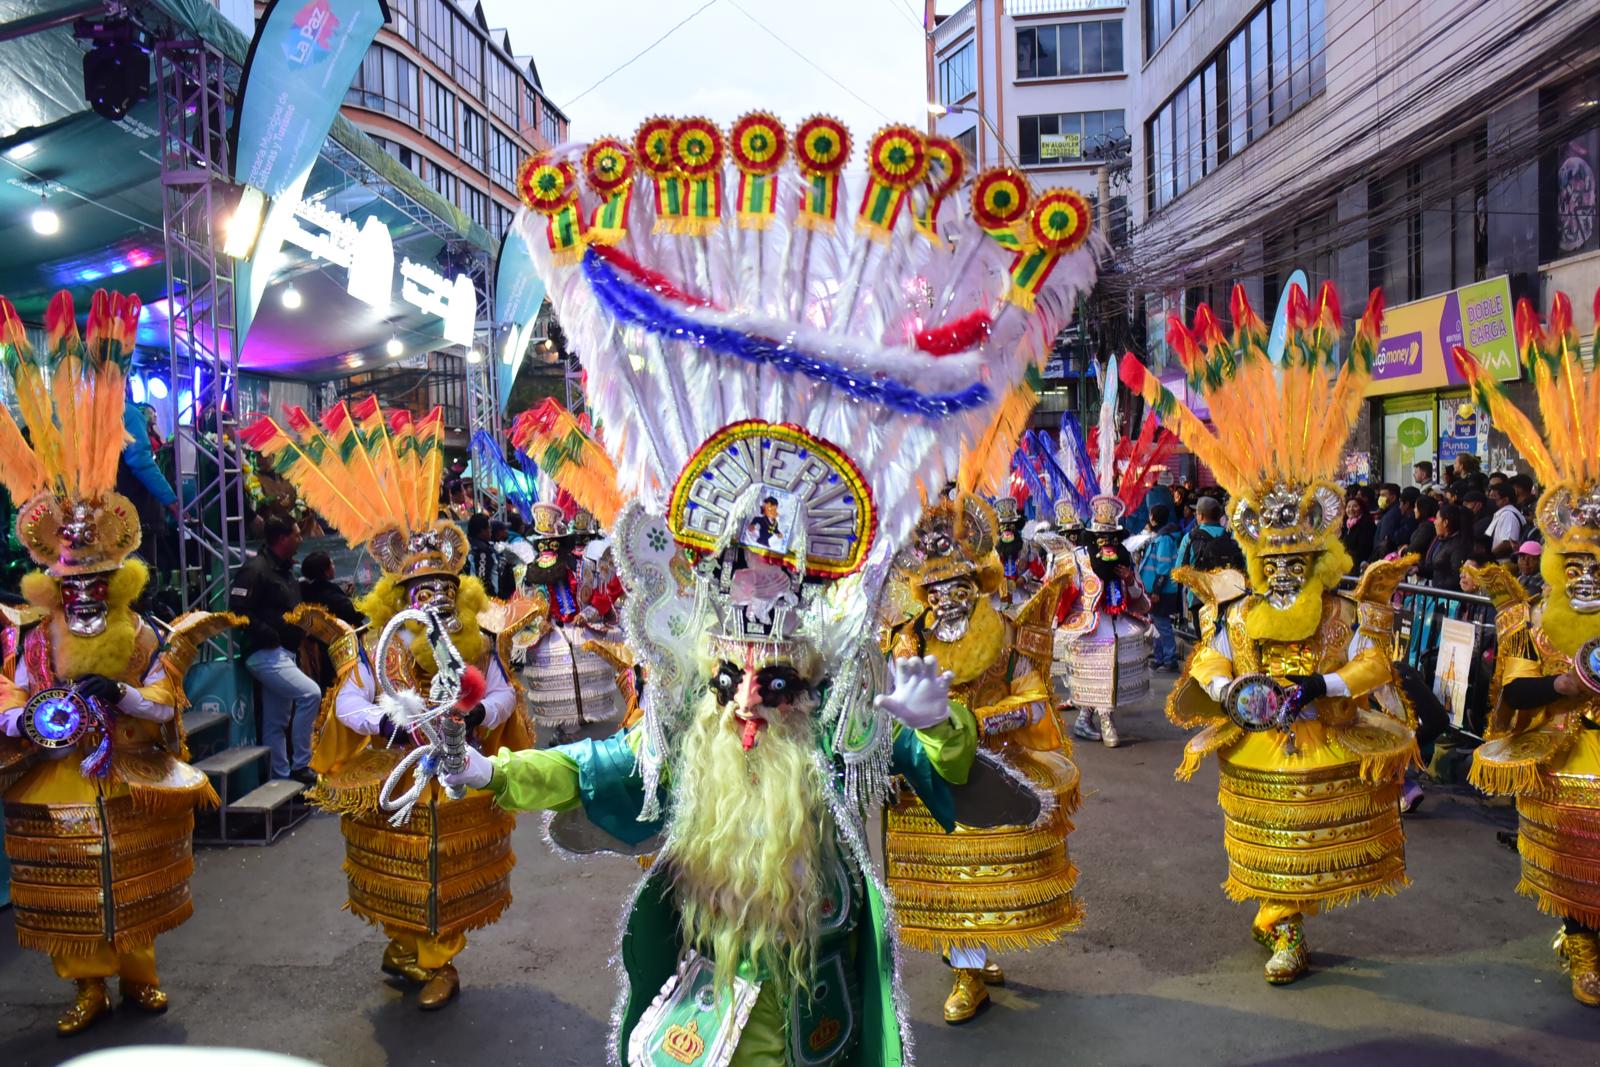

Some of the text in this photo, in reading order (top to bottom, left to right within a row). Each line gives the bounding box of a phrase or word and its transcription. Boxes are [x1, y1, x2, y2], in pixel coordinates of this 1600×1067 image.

[289, 6, 326, 63] La Paz
[256, 148, 279, 190] Culturas
[1467, 295, 1503, 325] DOBLE
[1469, 318, 1508, 347] CARGA
[1442, 440, 1470, 450] Punto
